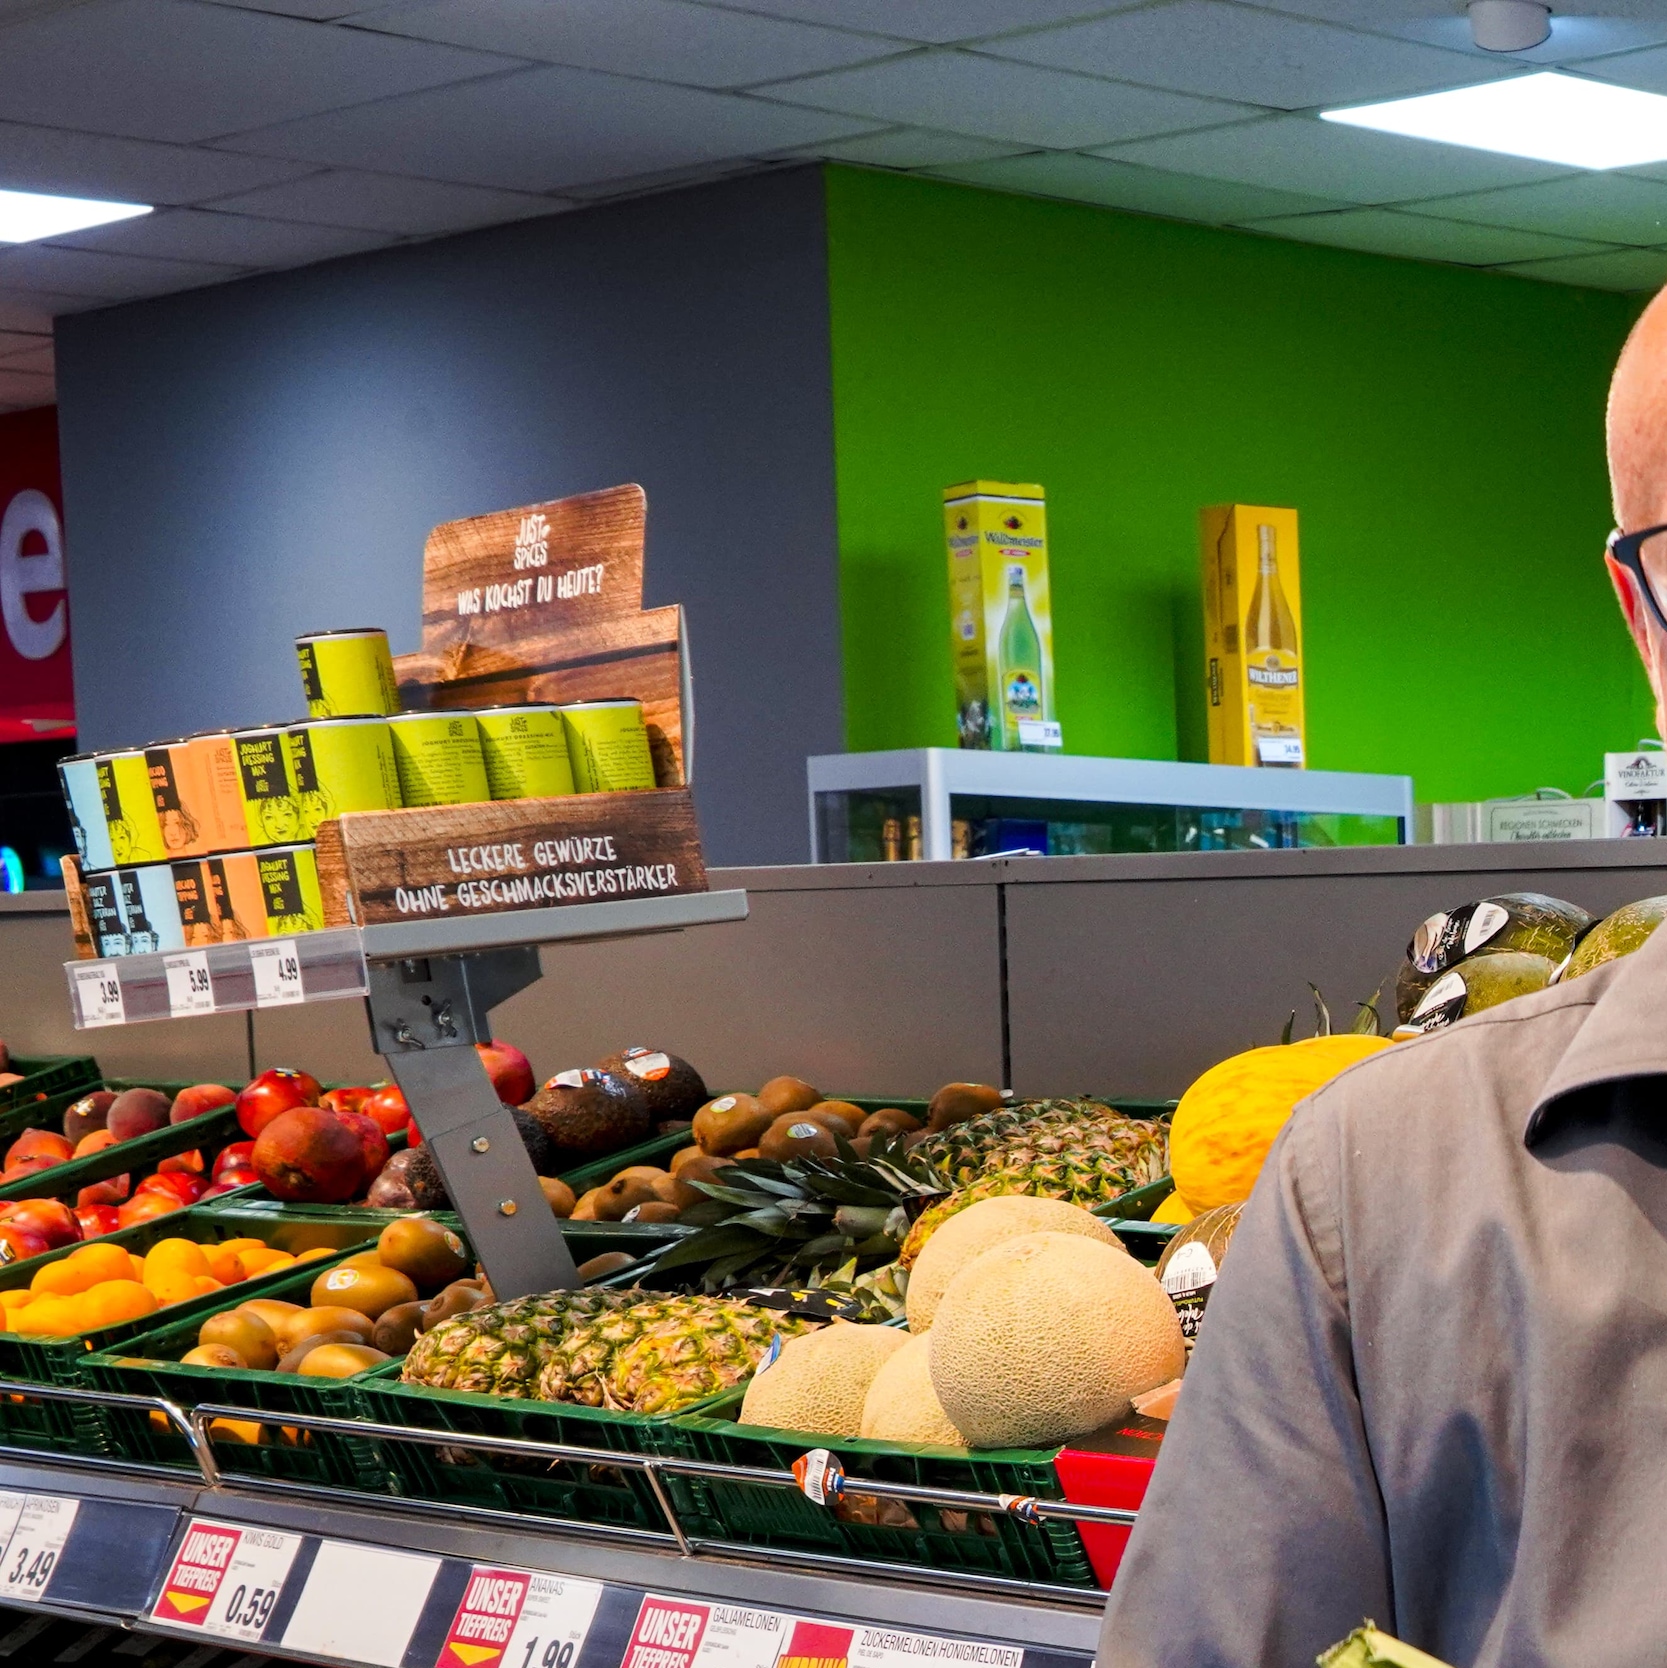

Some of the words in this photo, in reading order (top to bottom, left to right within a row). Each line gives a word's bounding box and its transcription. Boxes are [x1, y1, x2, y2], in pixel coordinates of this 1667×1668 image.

[515, 514, 547, 546] JUST
[458, 588, 480, 615] WAS
[485, 578, 532, 612] KOCHST
[537, 575, 553, 602] DU
[557, 564, 604, 599] HEUTE?
[1618, 769, 1665, 780] VINOFAKTUR
[1500, 820, 1537, 831] REGIONEN
[1538, 819, 1583, 830] SCHMECKEN
[448, 843, 526, 873] LECKERE
[533, 836, 617, 866] GEWÜRZE
[395, 884, 449, 913] OHNE
[457, 864, 678, 908] GESCHMACKSVERSTÄRKER
[189, 969, 210, 992] 5.99
[278, 957, 298, 982] 4.99
[100, 980, 119, 1004] 3.99
[182, 1531, 234, 1568] UNSER
[263, 1534, 284, 1549] GOLD
[9, 1548, 55, 1587] 3.49
[172, 1564, 221, 1592] TIEFPREIS
[465, 1577, 523, 1616] UNSER
[530, 1577, 565, 1596] ANANAS
[225, 1584, 275, 1629] 0.59
[713, 1607, 781, 1632] GALIAMELONEN
[456, 1612, 512, 1642] TIEFPREIS
[638, 1607, 702, 1650] UNSER
[861, 1630, 938, 1658] ZUCKERMELONEN
[940, 1642, 1019, 1667] HONIGMELONEN
